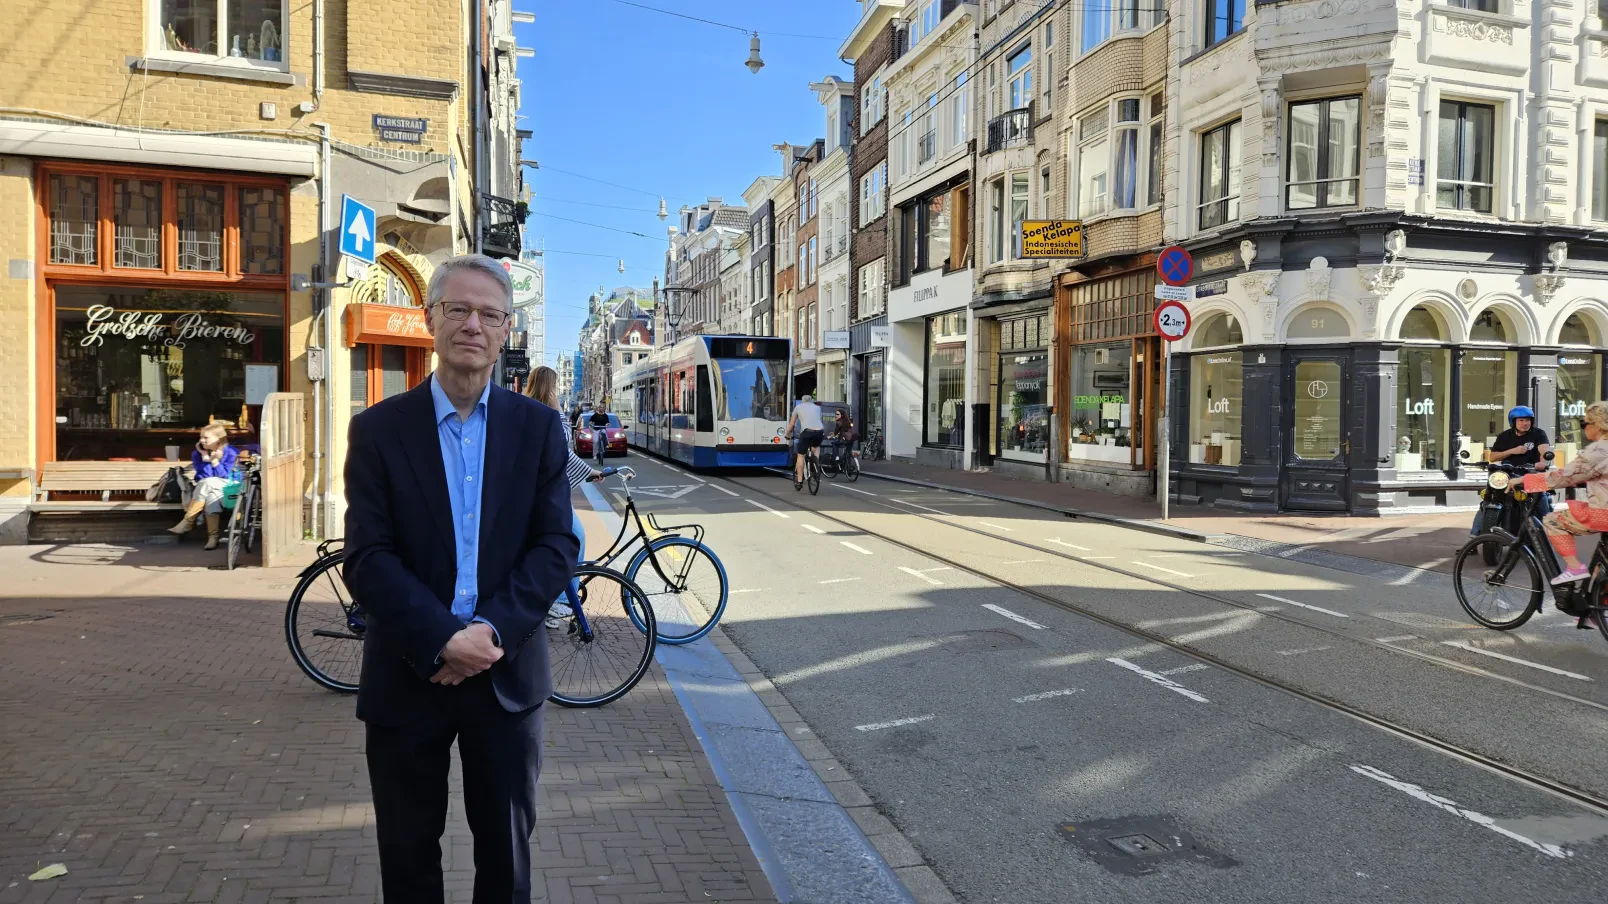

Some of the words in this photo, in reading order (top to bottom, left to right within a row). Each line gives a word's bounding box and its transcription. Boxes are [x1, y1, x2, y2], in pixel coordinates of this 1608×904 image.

[376, 117, 423, 129] KERKSTRAAT
[383, 131, 419, 141] CENTRUM
[1022, 220, 1062, 239] Soenda
[1043, 225, 1080, 241] Kelapa
[1025, 248, 1079, 256] Specialiteiten
[164, 312, 255, 349] Bieren
[1311, 319, 1325, 328] 91
[746, 341, 754, 355] 4
[1208, 397, 1230, 413] Loft
[1405, 398, 1434, 415] Loft
[1560, 399, 1587, 416] Loft
